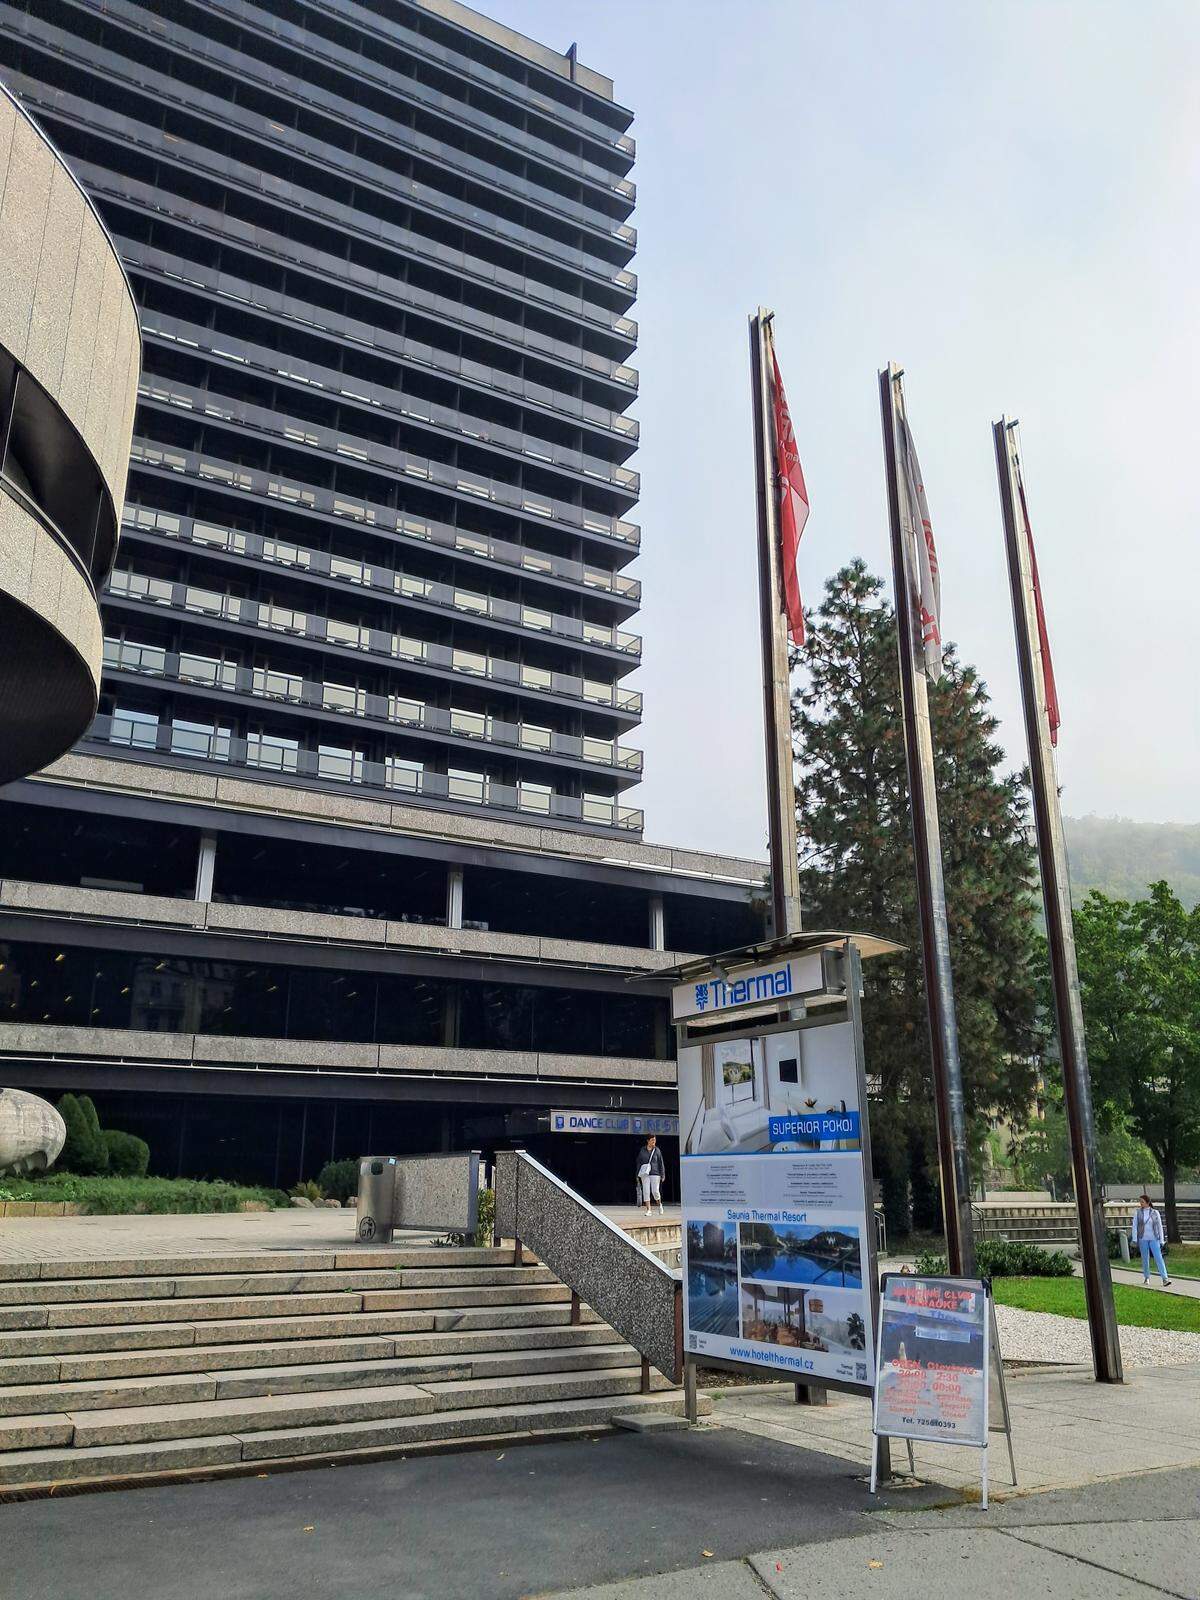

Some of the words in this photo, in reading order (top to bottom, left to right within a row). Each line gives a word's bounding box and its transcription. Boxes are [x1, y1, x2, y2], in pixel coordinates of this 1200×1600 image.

[709, 963, 793, 1008] Thermal
[569, 1116, 602, 1129] DANCE
[772, 1120, 820, 1135] SUPERIOR
[822, 1118, 853, 1133] POKOJ
[727, 1209, 750, 1221] Saunia
[751, 1210, 781, 1222] Thermal
[782, 1212, 807, 1223] Resort
[730, 1346, 814, 1370] www.hotelthermal.cz
